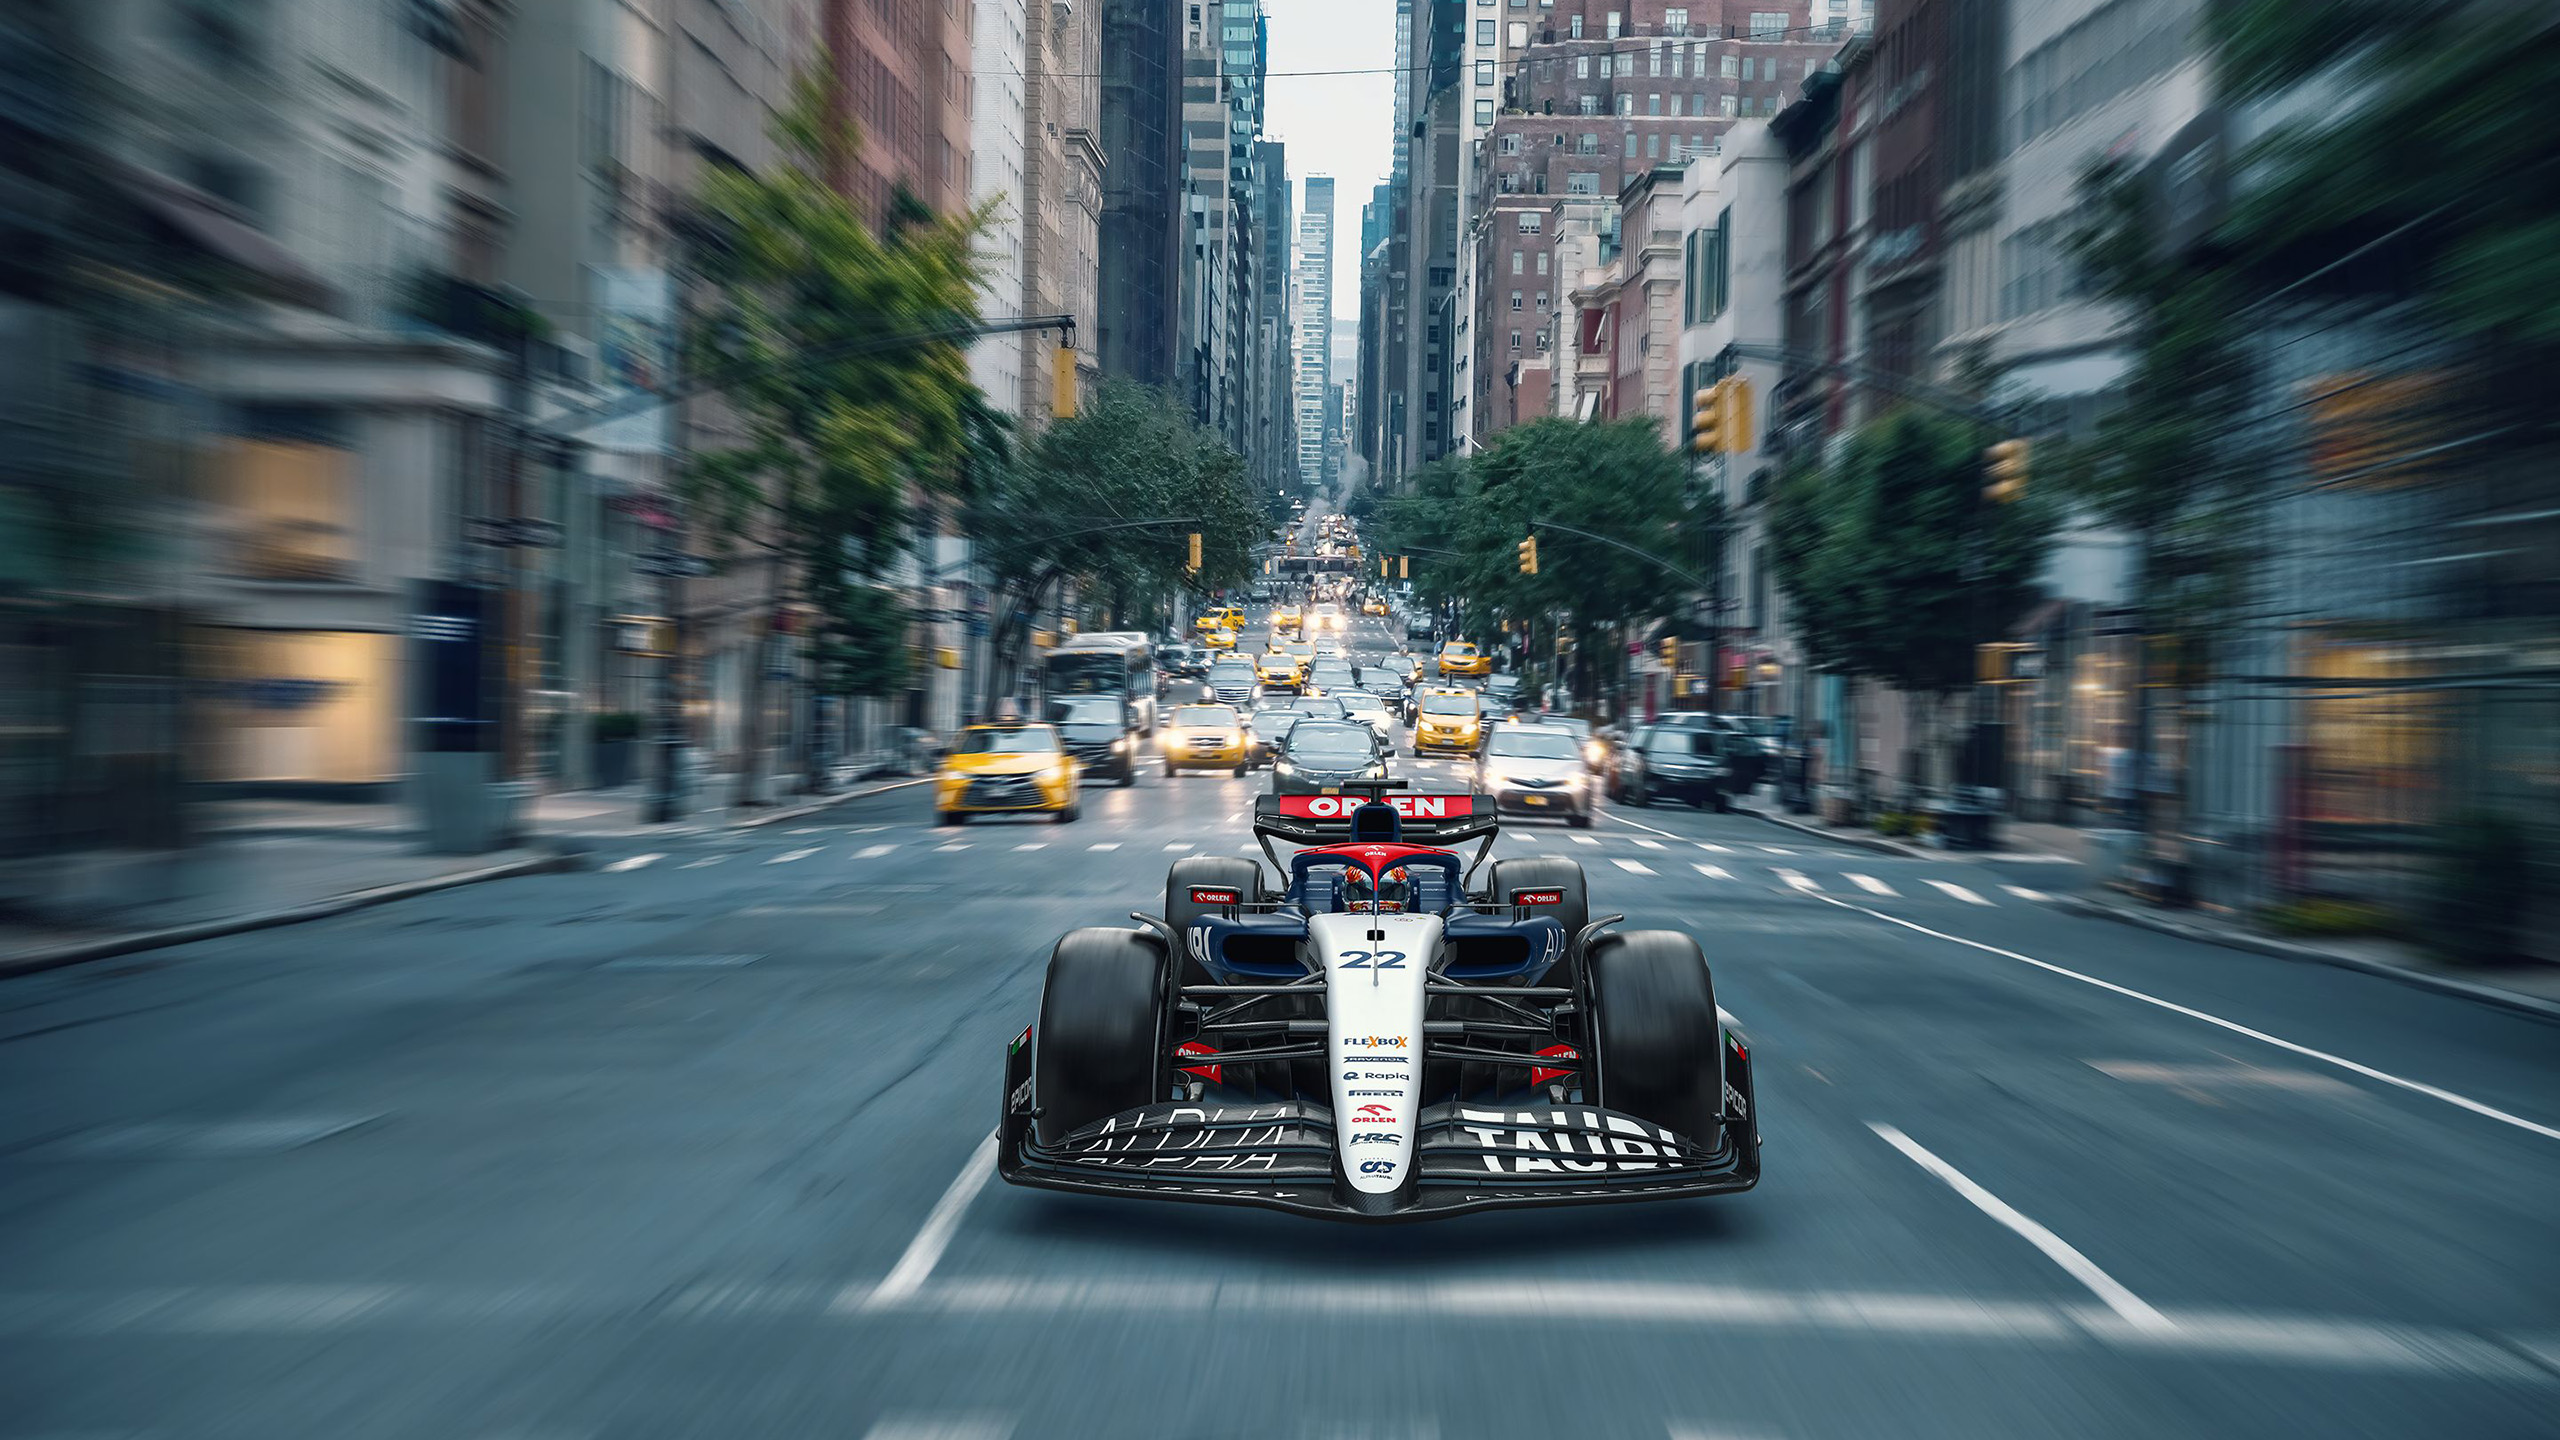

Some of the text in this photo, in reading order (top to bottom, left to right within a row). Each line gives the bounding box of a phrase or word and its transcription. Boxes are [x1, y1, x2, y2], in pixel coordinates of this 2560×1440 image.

[1308, 797, 1446, 816] OREN
[1206, 894, 1230, 902] ORLEN
[1338, 951, 1406, 969] 22
[1344, 1036, 1408, 1049] FLEXBOX
[1365, 1072, 1409, 1081] Rapiq
[1350, 1133, 1403, 1144] HRC
